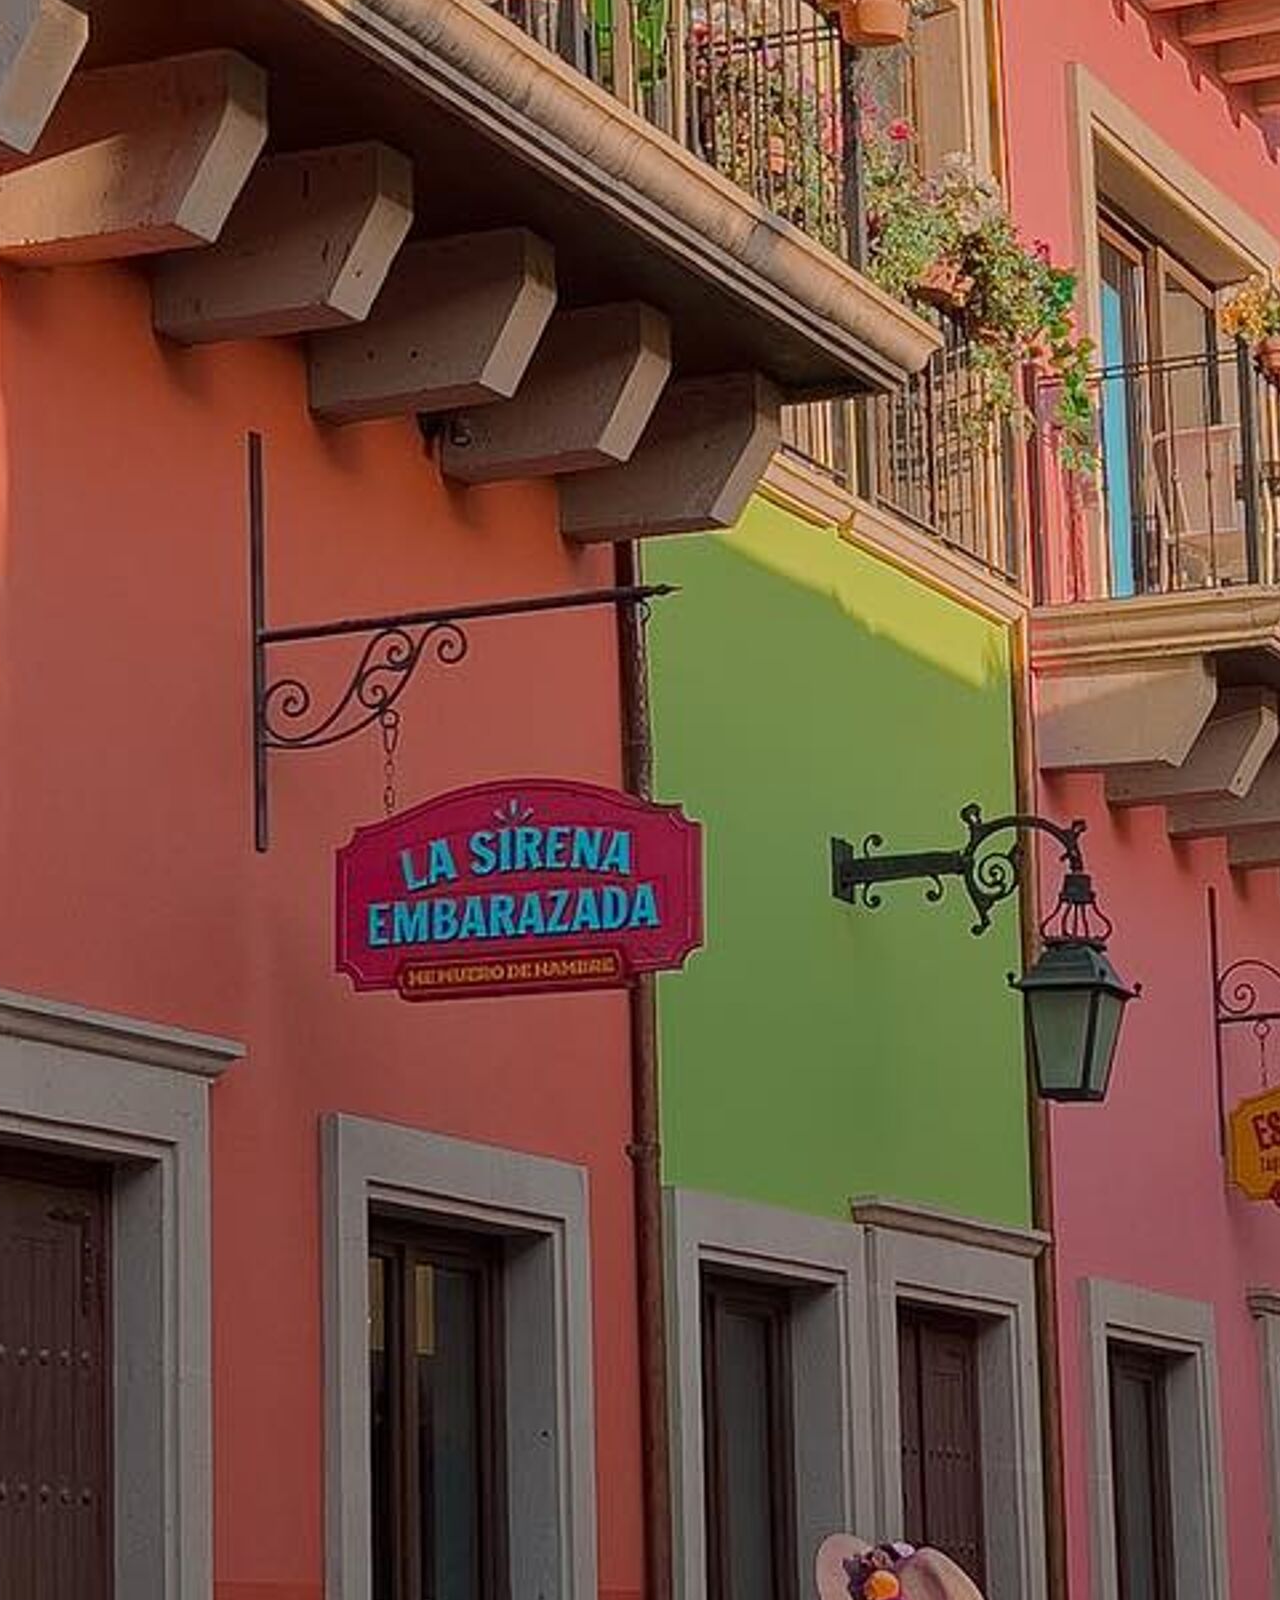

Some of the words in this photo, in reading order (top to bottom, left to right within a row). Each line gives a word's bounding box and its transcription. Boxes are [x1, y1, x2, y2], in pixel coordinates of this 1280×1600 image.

[399, 839, 457, 891] LA
[470, 826, 632, 877] SIRENA
[368, 883, 661, 948] EMBARAZADA
